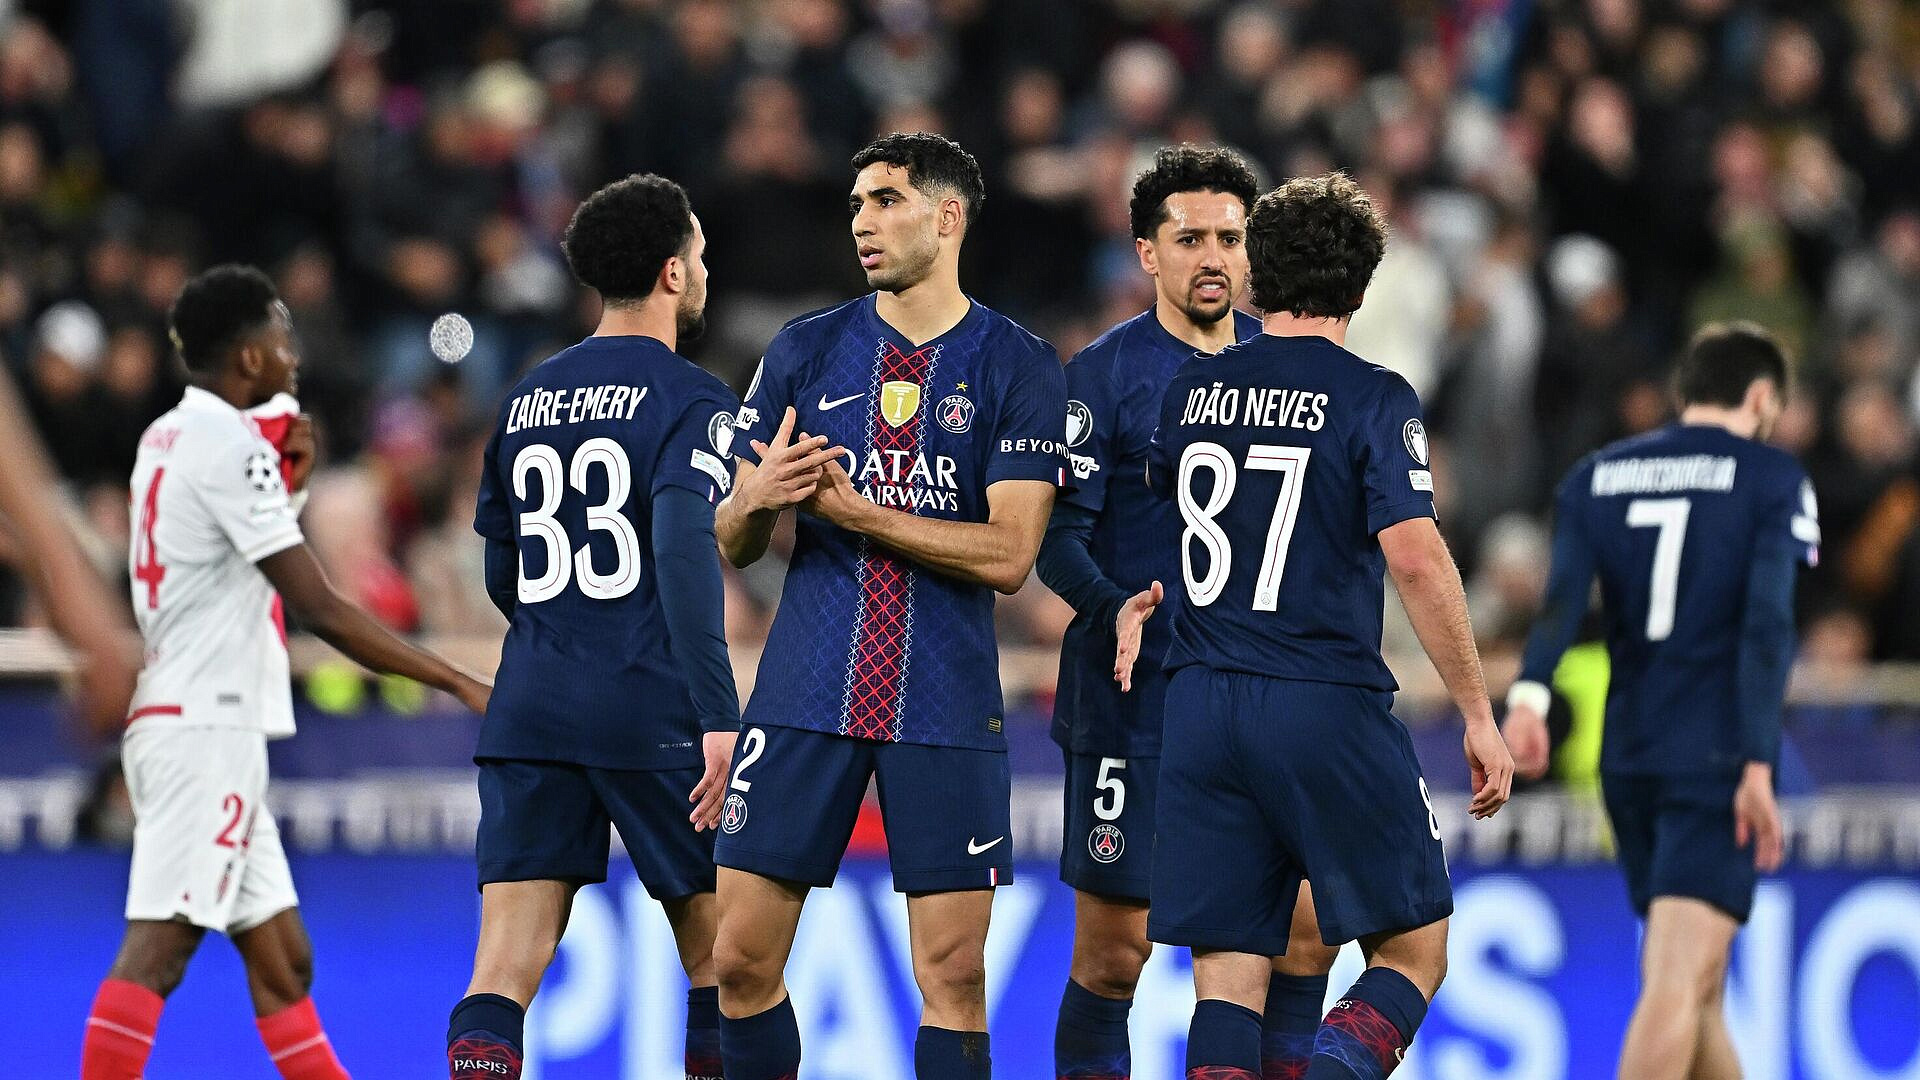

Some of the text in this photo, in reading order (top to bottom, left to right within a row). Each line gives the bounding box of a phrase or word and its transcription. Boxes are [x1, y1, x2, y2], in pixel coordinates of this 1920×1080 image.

[506, 385, 648, 434] ZAÏRE-EMERY
[945, 398, 971, 410] PARIS
[1180, 382, 1329, 431] JOÃO NEVES
[1001, 439, 1070, 460] BEYOND
[512, 437, 641, 604] 33
[861, 485, 958, 512] AIRWAYS
[1177, 441, 1312, 612] 87
[1625, 498, 1692, 641] 7
[731, 727, 766, 792] 2
[1093, 757, 1126, 820] 5
[1095, 826, 1119, 838] PARIS
[454, 1059, 508, 1074] PARIS
